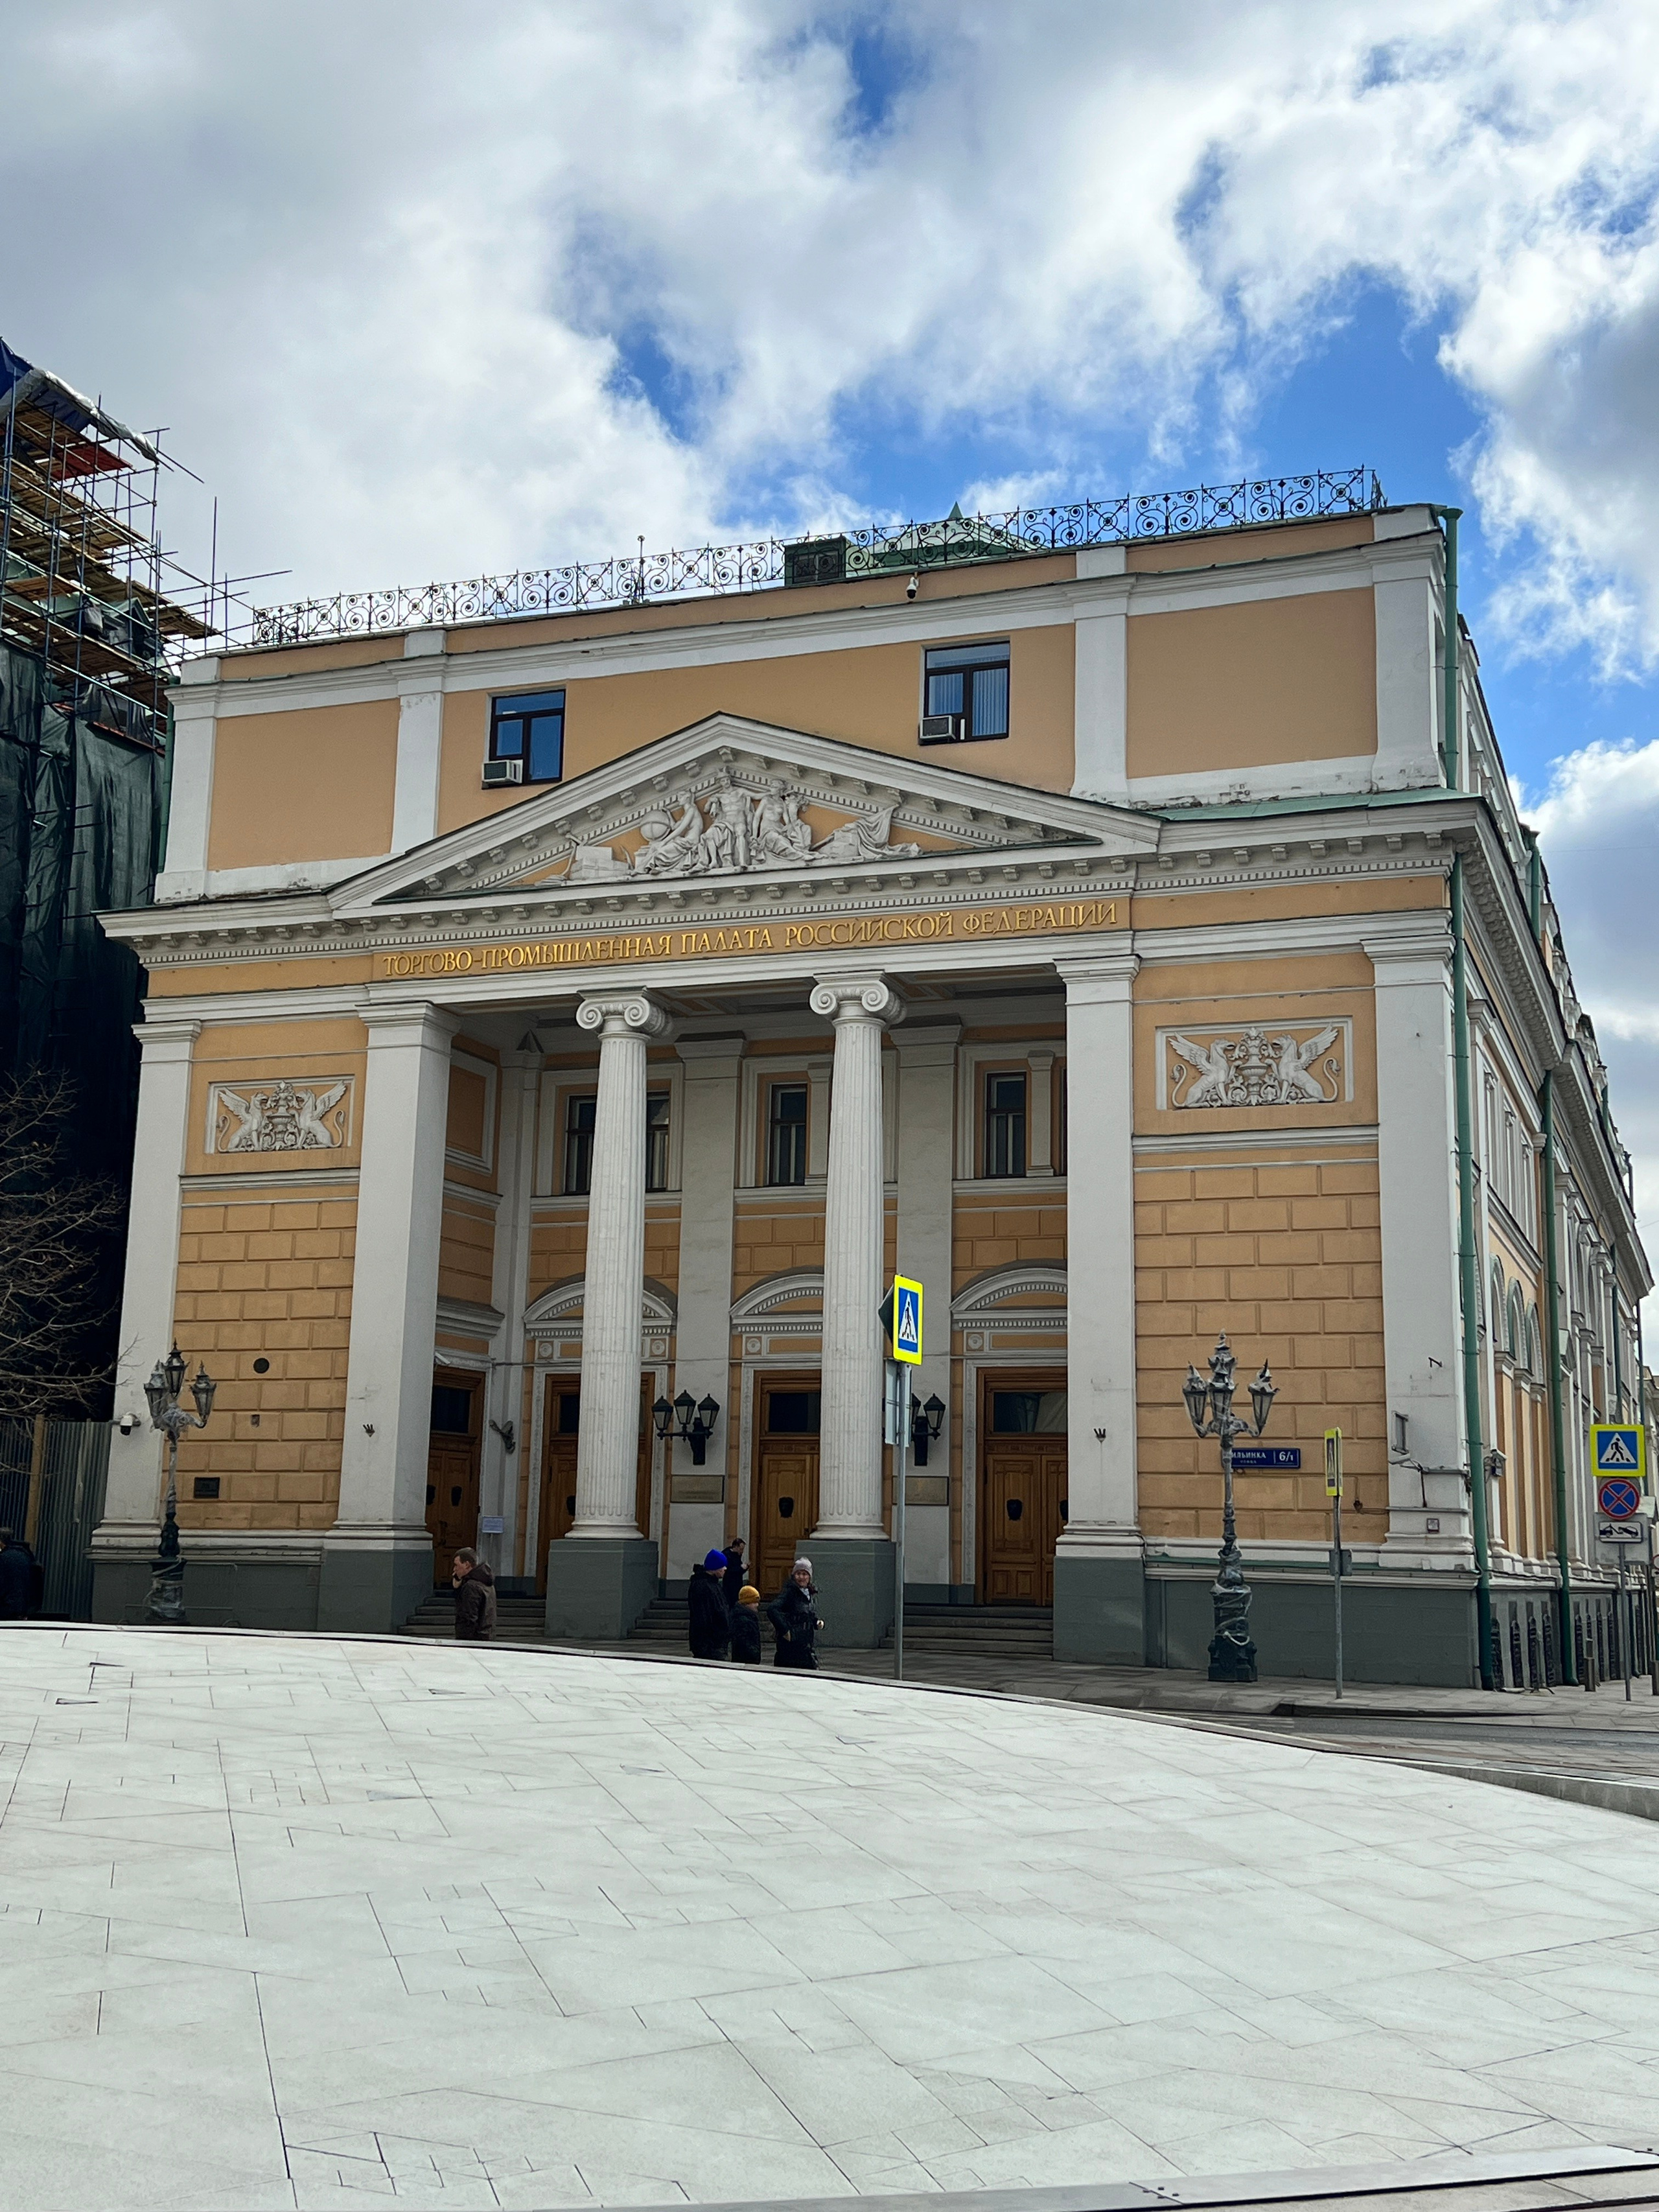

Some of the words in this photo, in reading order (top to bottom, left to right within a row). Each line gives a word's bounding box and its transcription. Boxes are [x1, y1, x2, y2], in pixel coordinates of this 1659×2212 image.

[383, 935, 672, 975] ТОРГОВО-ПРОМЫШЛЕННАЯ
[680, 927, 774, 954] ПАЛАТА
[785, 911, 954, 947] РОССИЙСКОЙ
[963, 903, 1117, 935] ФЕДЕРАЦИИ
[1279, 1451, 1294, 1461] 6/1
